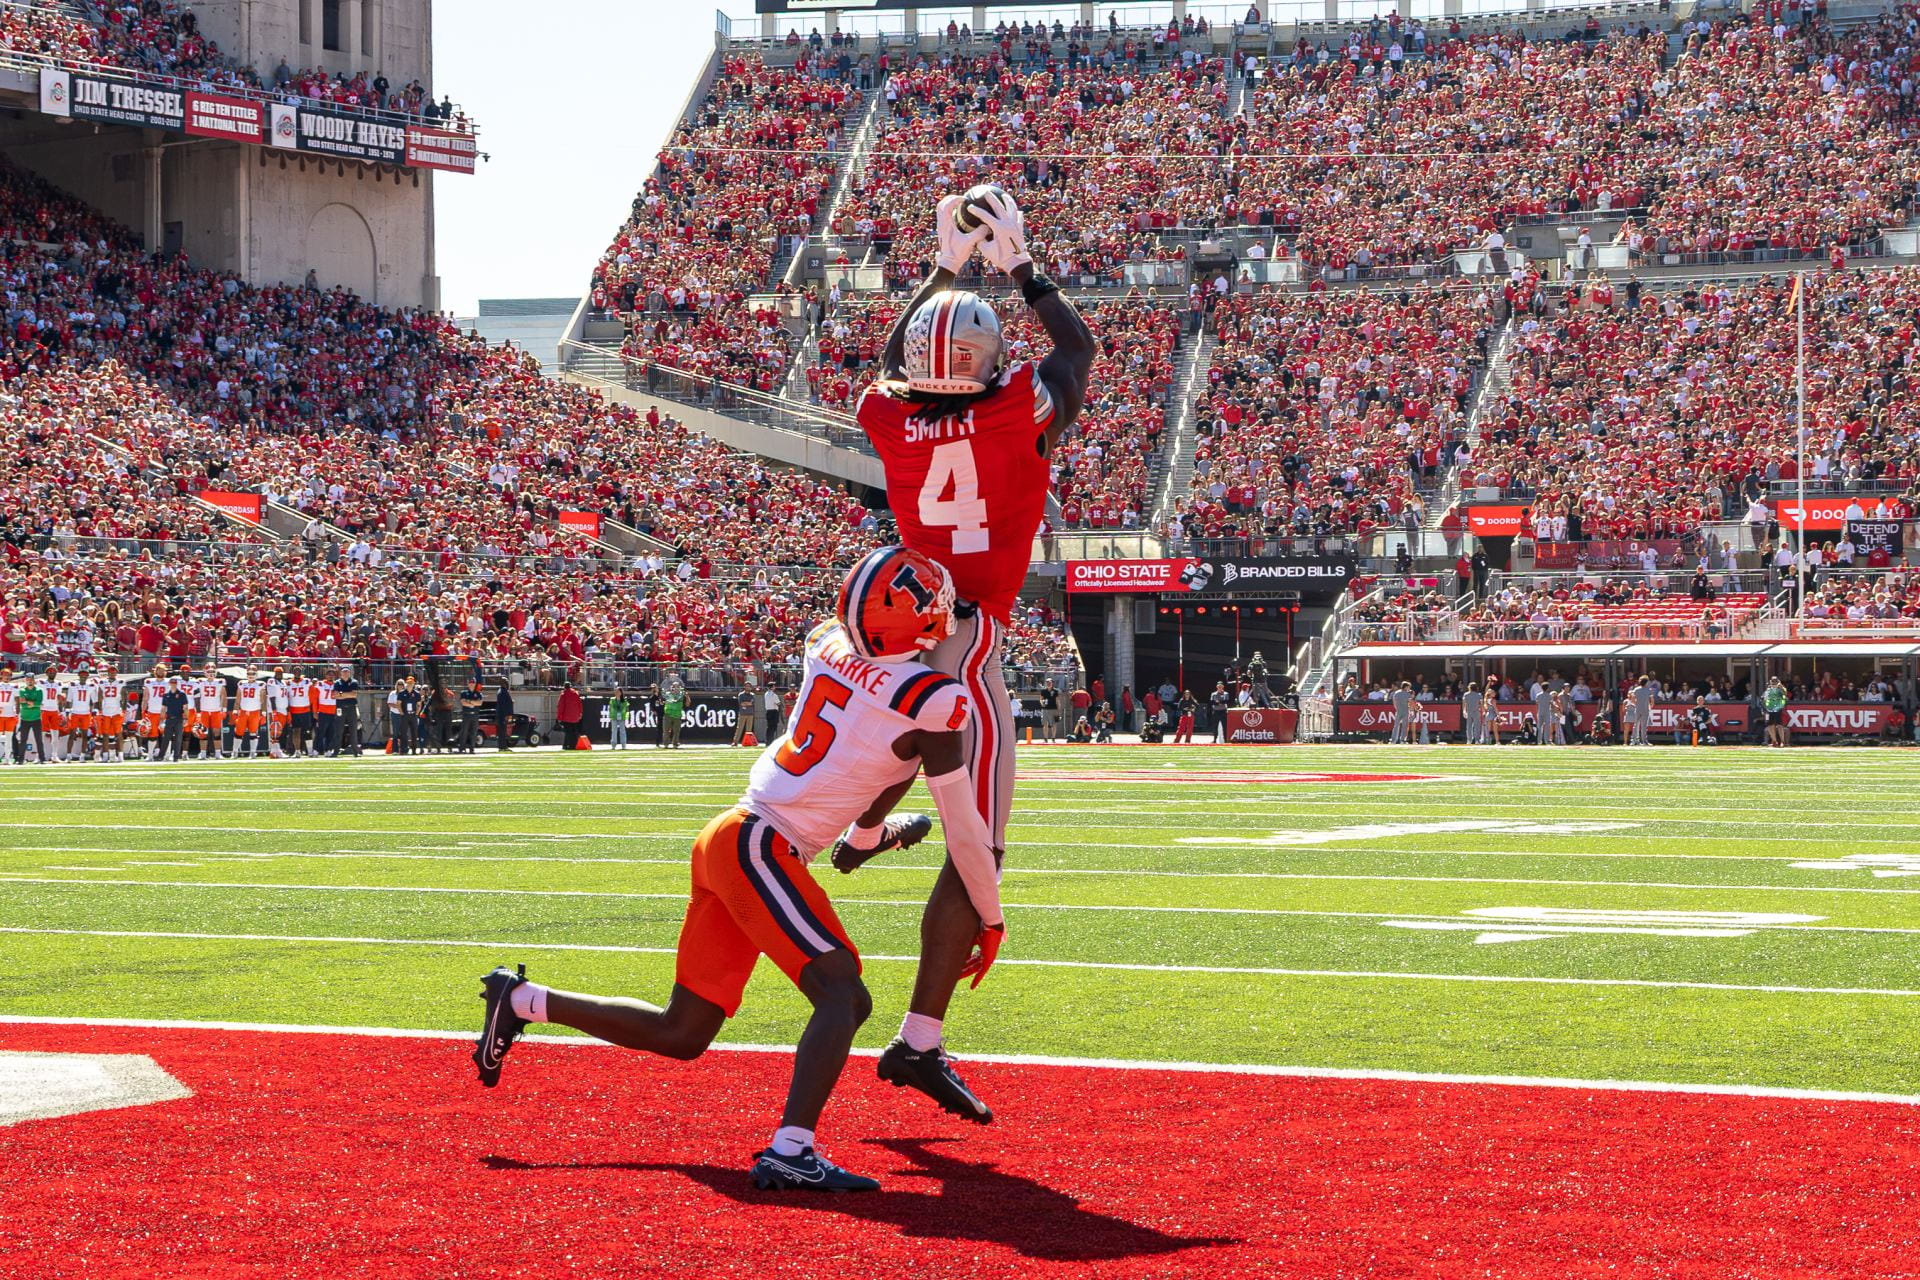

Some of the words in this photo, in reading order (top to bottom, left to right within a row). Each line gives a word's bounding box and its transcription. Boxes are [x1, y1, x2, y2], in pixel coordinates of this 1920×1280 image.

[74, 79, 107, 106] JIM
[109, 83, 184, 117] TRESSEL
[74, 105, 89, 114] OHIO
[90, 108, 108, 117] STATE
[109, 110, 125, 120] HEAD
[125, 112, 145, 122] COACH
[192, 100, 199, 112] 6
[200, 101, 215, 114] BIG
[216, 103, 231, 116] TEN
[231, 105, 257, 120] TITLES
[192, 115, 198, 127] 1
[198, 116, 237, 132] NATIONAL
[237, 121, 259, 136] TITLE
[300, 113, 355, 142] WOODY
[357, 121, 405, 150] HAYES
[409, 147, 416, 160] 5
[912, 382, 974, 391] BUCKEYES
[904, 409, 976, 443] SMITH
[918, 439, 989, 555] 4
[1488, 517, 1521, 525] DOORDA
[1850, 523, 1899, 534] DEFEND
[1862, 534, 1887, 544] THE
[1856, 544, 1893, 554] 'SHE
[1074, 565, 1116, 579] OHIO
[1118, 564, 1171, 578] STATE
[1240, 566, 1305, 578] BRANDED
[1308, 565, 1346, 577] BILLS
[1074, 580, 1103, 588] Officially
[890, 565, 936, 616] I
[818, 640, 892, 696] CLARKE
[78, 690, 87, 701] 11
[104, 686, 117, 697] 23
[152, 686, 165, 697] 78
[204, 686, 216, 697] 53
[243, 687, 255, 698] 68
[292, 687, 304, 697] 75
[1377, 712, 1442, 724] ANURIL
[1787, 709, 1877, 728] XTRATUF
[1230, 729, 1274, 741] Allstate
